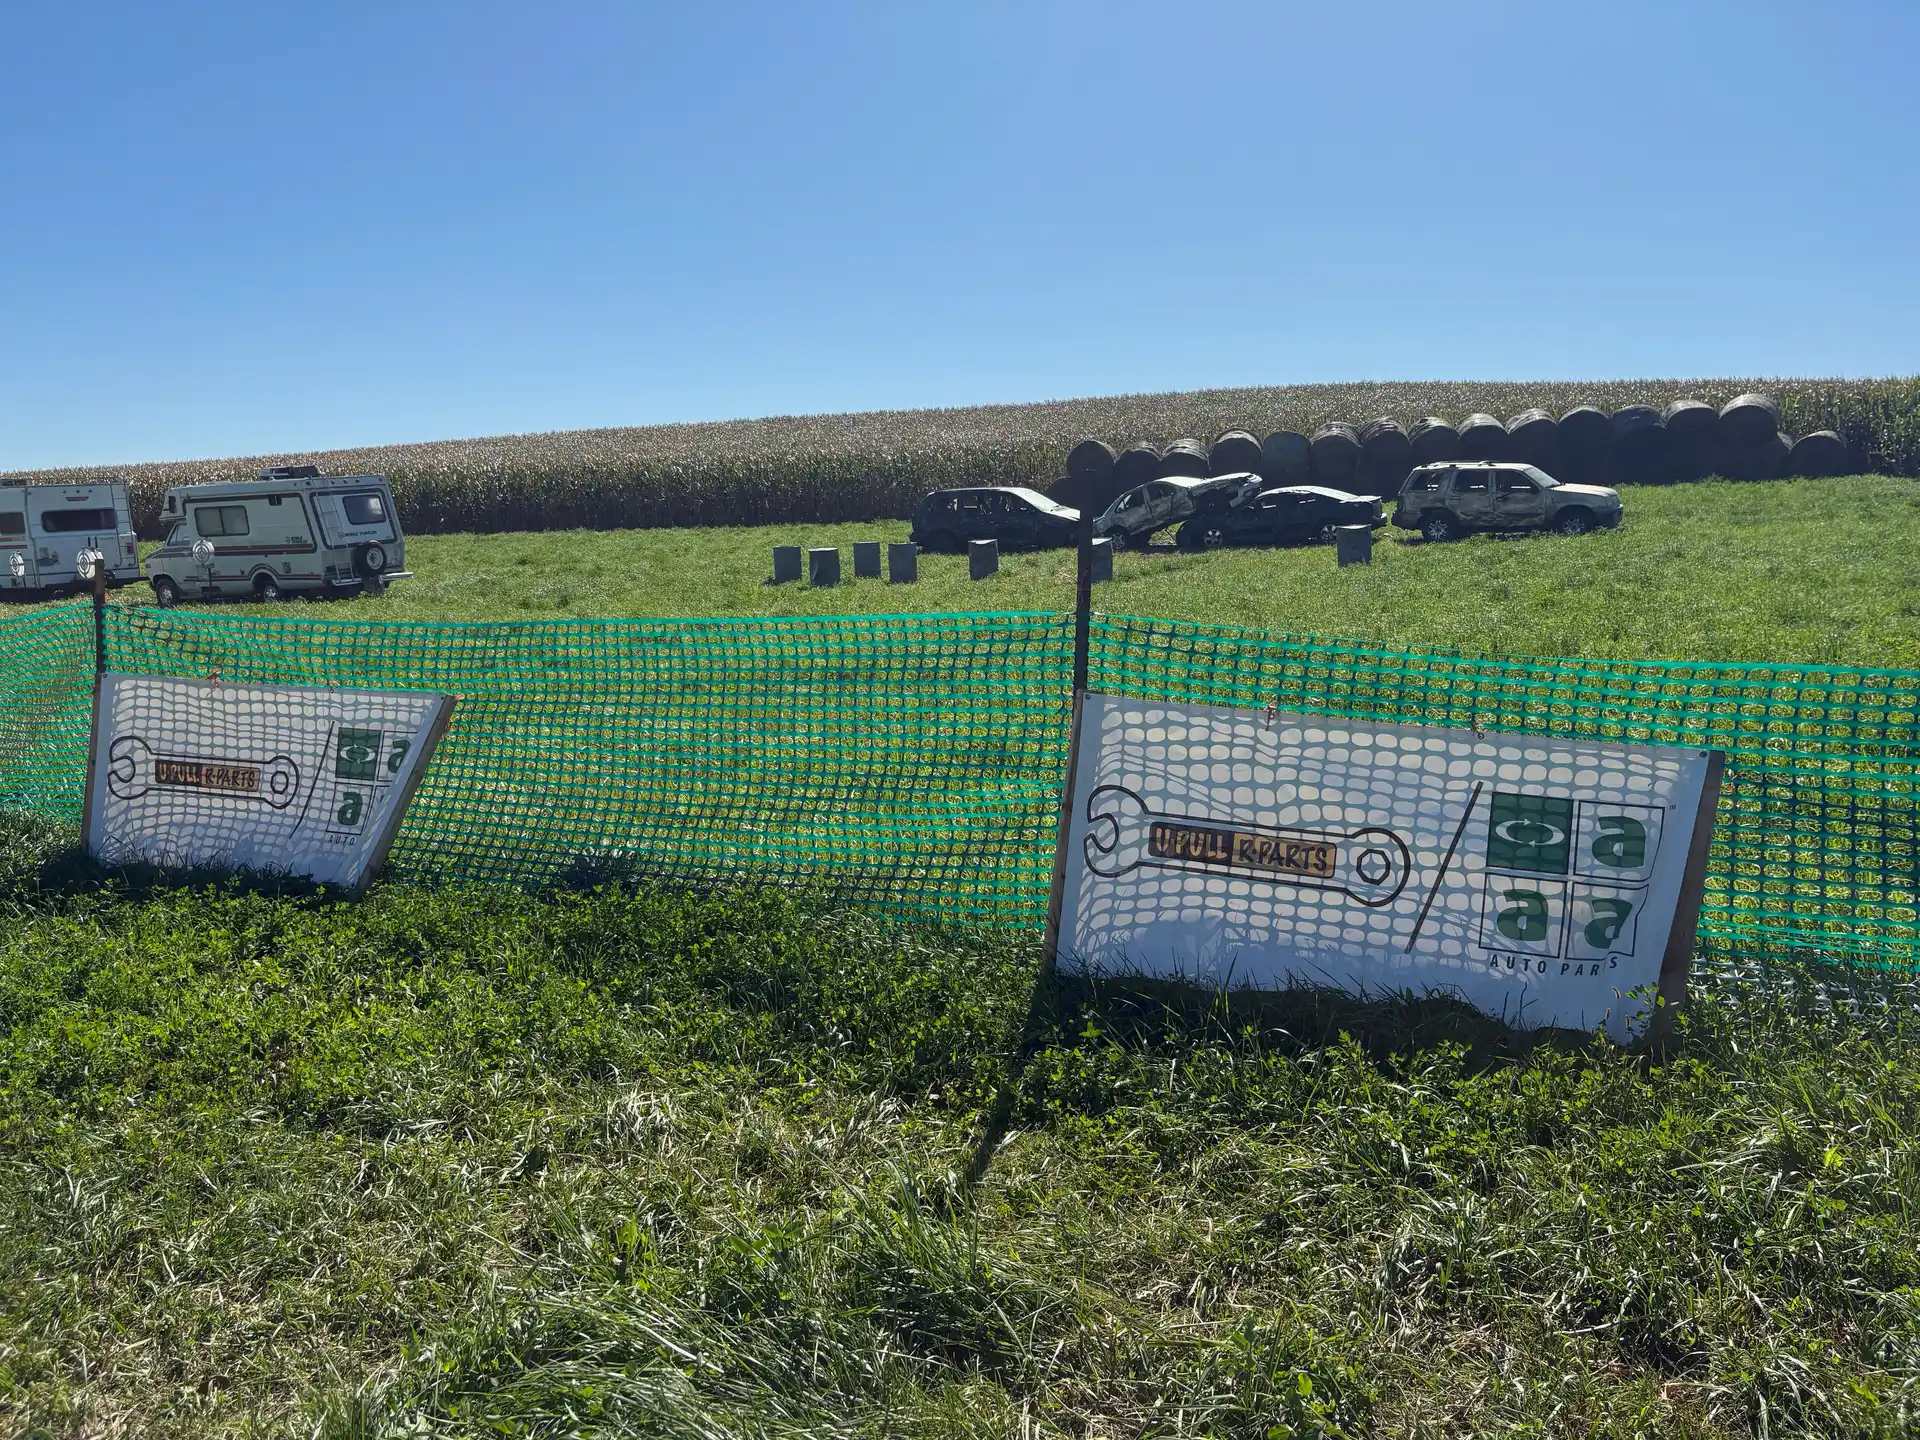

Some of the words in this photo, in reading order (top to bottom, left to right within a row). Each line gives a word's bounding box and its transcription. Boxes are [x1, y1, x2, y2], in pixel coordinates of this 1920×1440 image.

[328, 835, 355, 846] AUTO
[1591, 815, 1647, 868] a
[1496, 888, 1549, 942] a
[1490, 954, 1547, 974] AUTO
[1560, 956, 1618, 976] PARS
